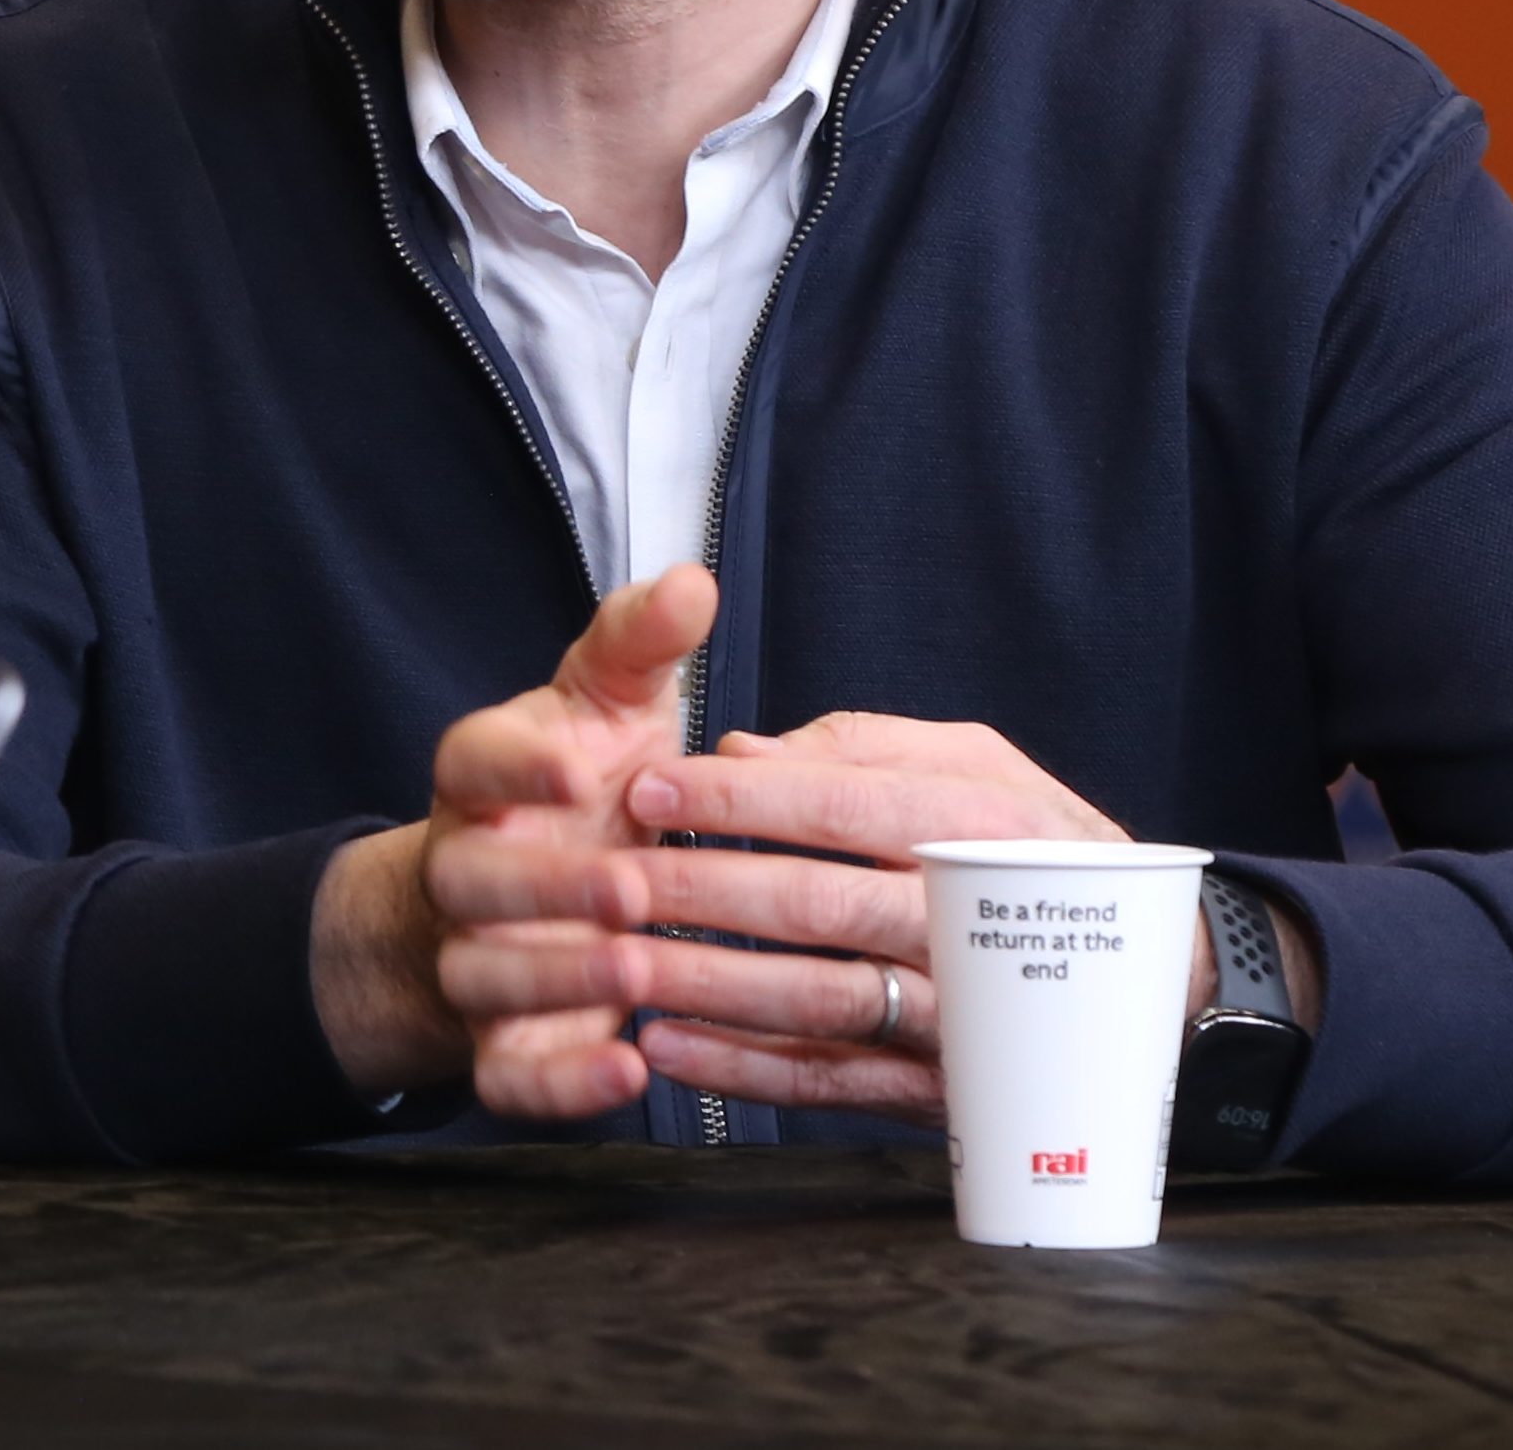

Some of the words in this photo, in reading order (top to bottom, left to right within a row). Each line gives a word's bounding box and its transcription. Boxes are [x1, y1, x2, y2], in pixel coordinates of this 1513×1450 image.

[979, 899, 1009, 921] Be
[1016, 905, 1030, 921] a
[1036, 901, 1117, 923] friend
[970, 930, 1046, 950] return
[1052, 933, 1078, 951] at
[1084, 931, 1124, 951] the
[1022, 960, 1068, 980] end
[1032, 1148, 1087, 1174] rai
